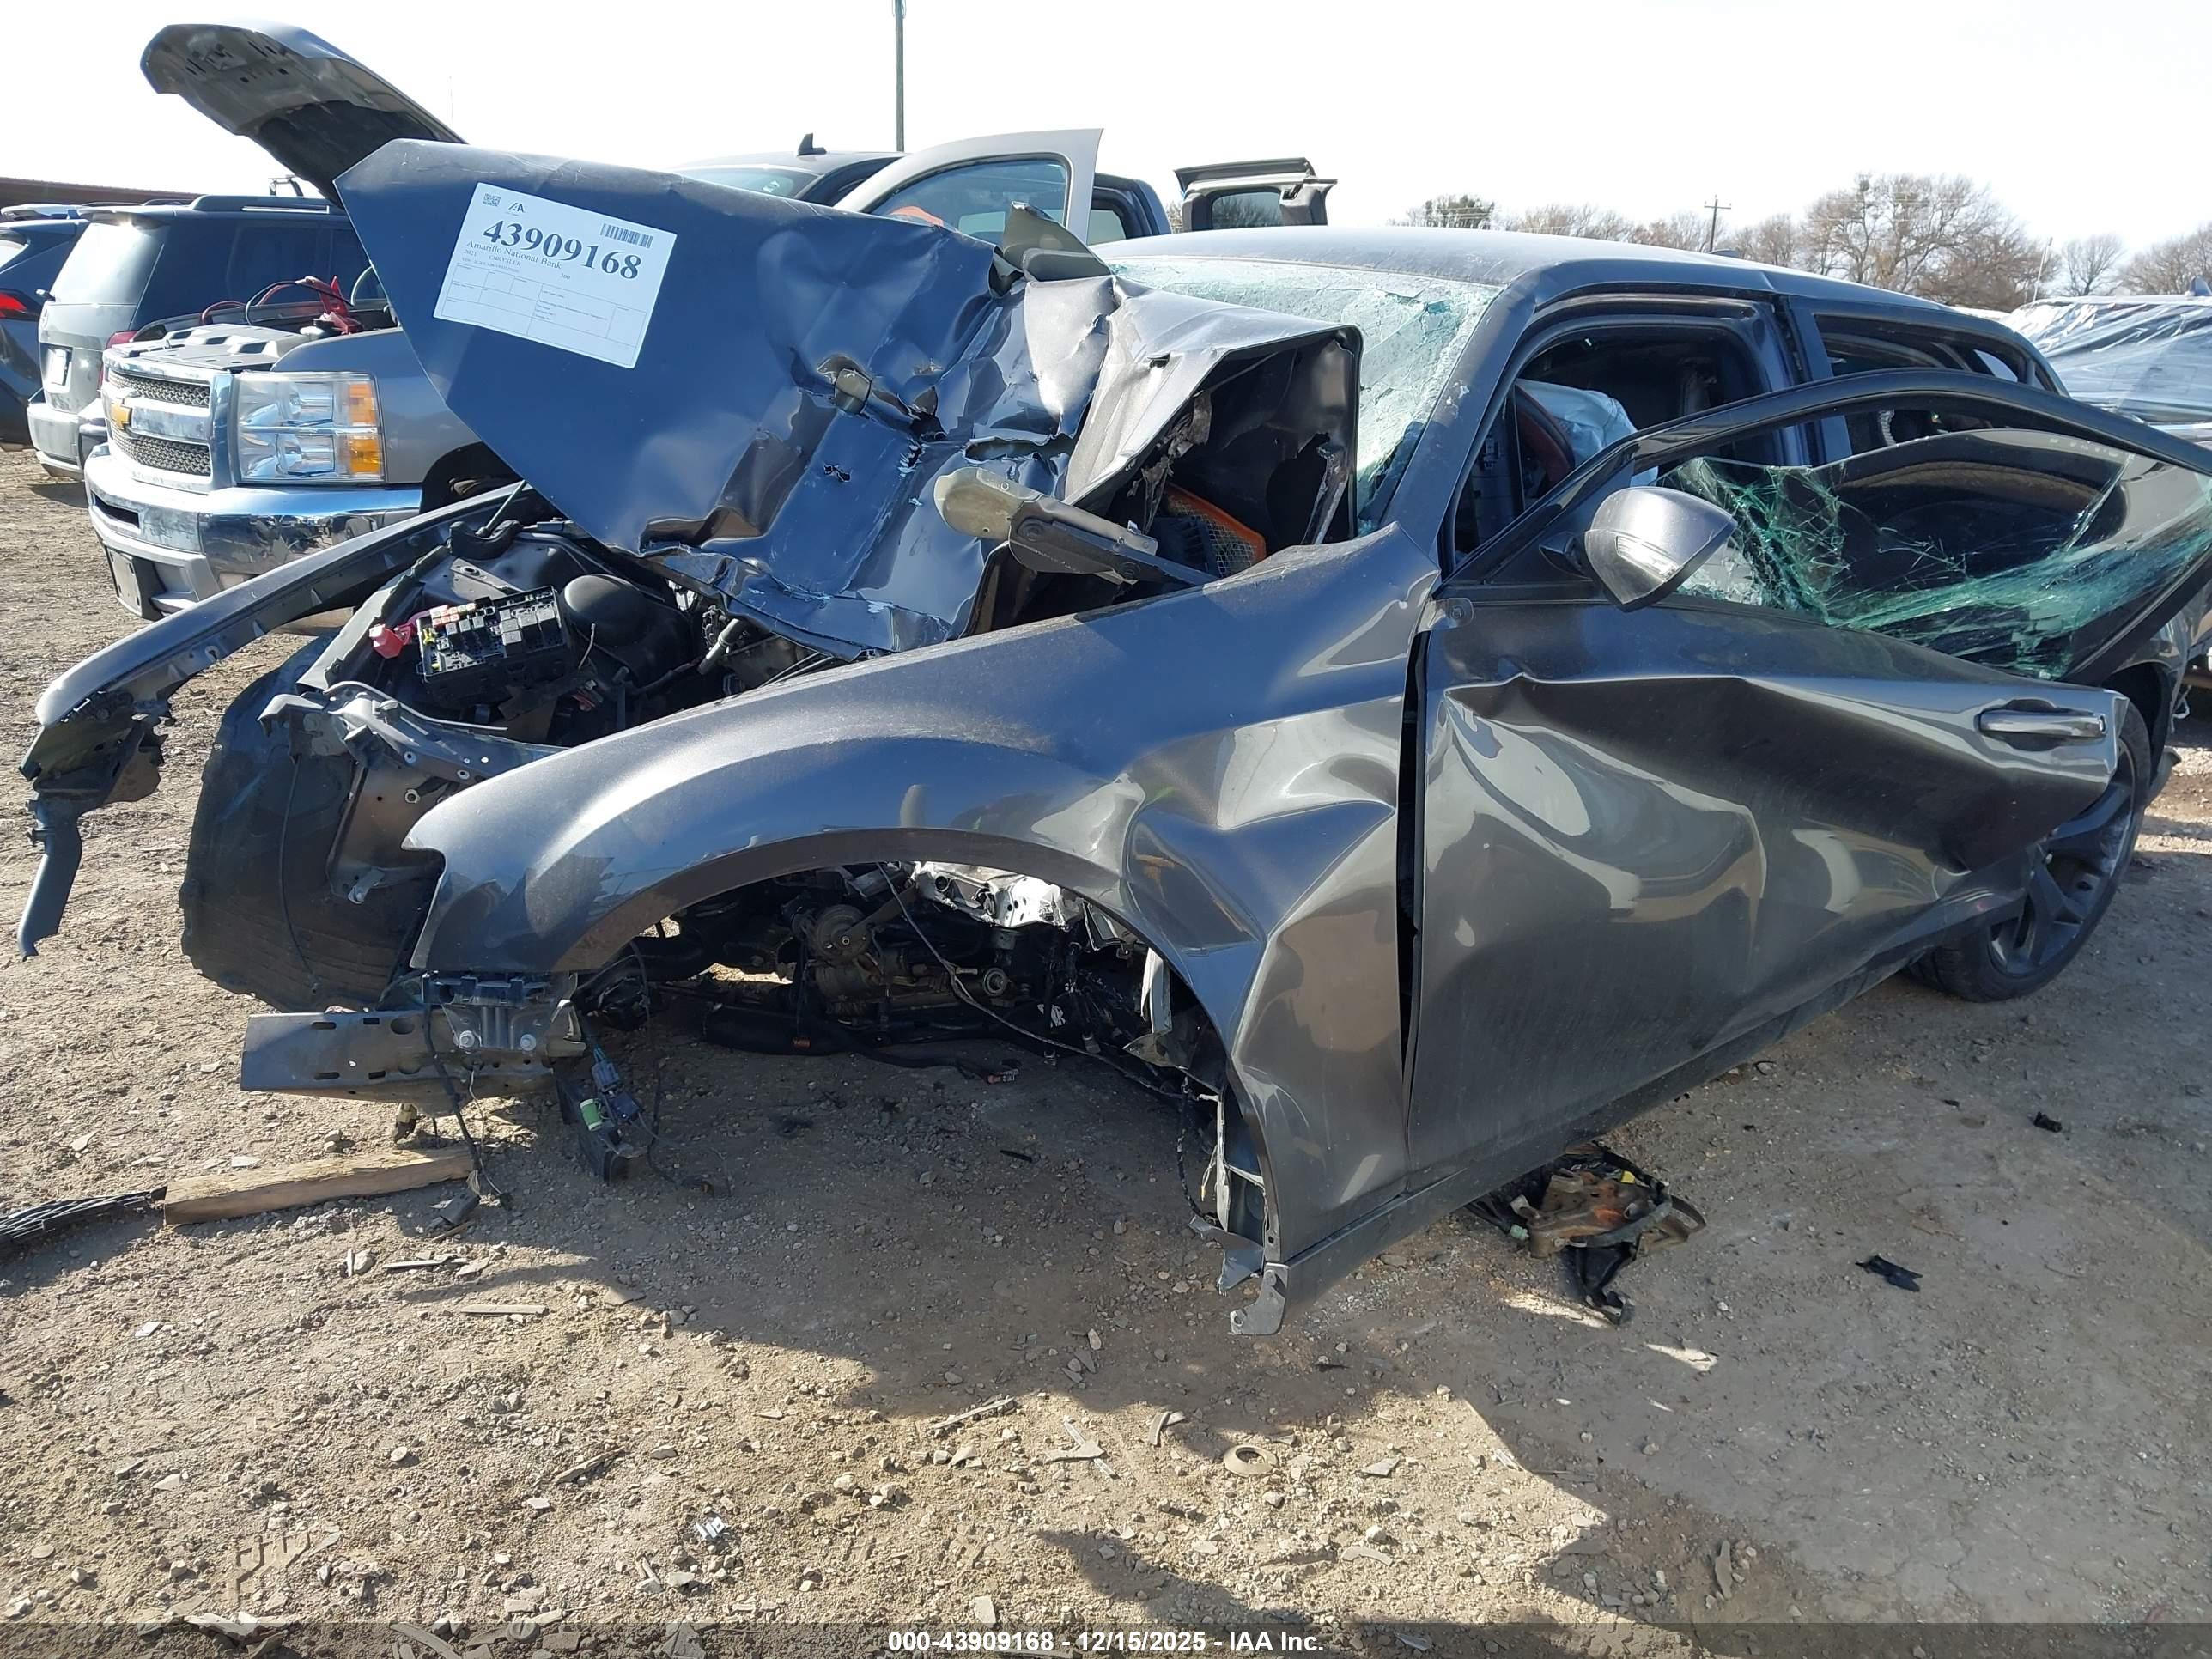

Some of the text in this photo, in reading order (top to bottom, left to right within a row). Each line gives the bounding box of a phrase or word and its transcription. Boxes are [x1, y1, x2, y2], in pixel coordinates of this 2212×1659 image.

[466, 240, 562, 270] Amarillo National Bank
[483, 220, 642, 280] 43909168
